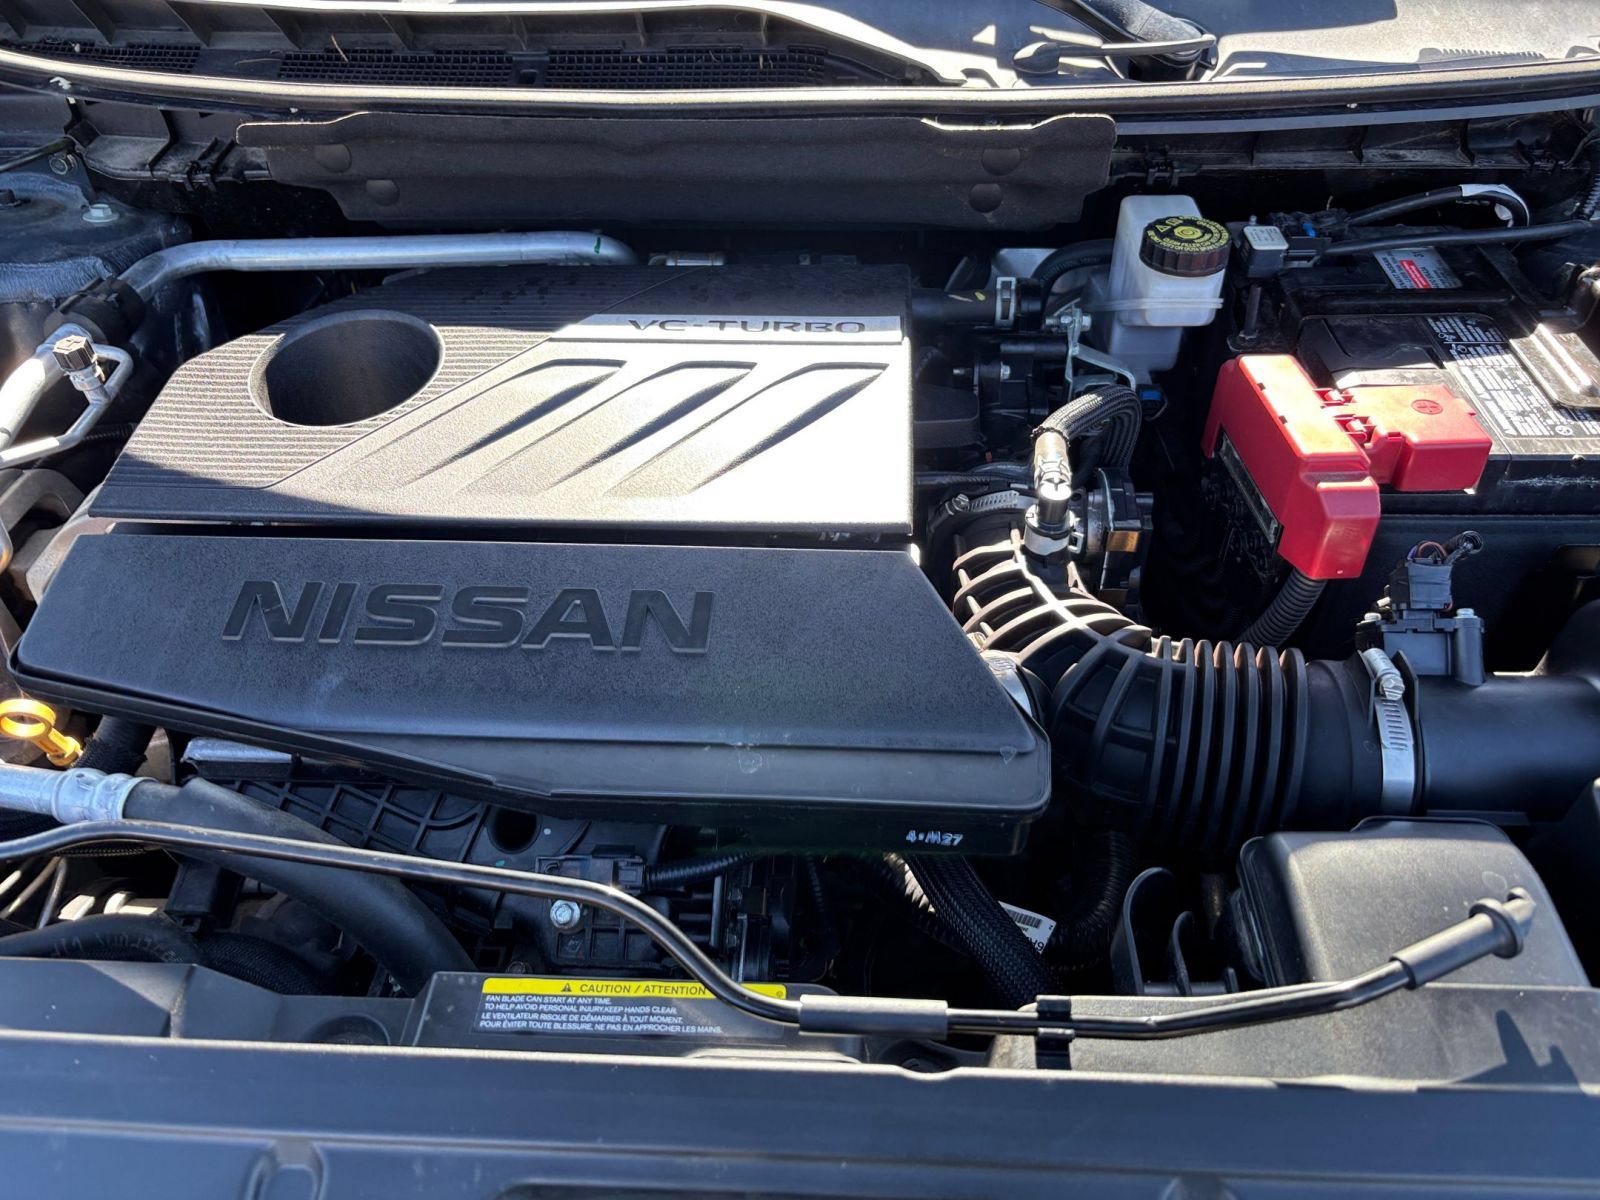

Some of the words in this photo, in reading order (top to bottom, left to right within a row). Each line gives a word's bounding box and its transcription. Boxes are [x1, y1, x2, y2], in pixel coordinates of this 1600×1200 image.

[628, 319, 866, 333] VC-TURBO
[222, 580, 715, 653] NISSAN
[580, 983, 631, 994] CAUTION
[634, 984, 641, 994] /
[643, 984, 707, 996] ATTENTION
[501, 995, 525, 1003] BLADE
[526, 995, 542, 1003] CAN
[543, 996, 566, 1004] START
[495, 1003, 515, 1011] HELP
[515, 1003, 538, 1011] AVOID
[539, 1004, 577, 1012] PERSONAL
[624, 1006, 650, 1014] HANDS
[492, 1012, 539, 1020] VENTILATEUR
[540, 1013, 567, 1021] RISQUE
[580, 1012, 621, 1022] DÉMARRER
[629, 1015, 649, 1023] TOUT
[649, 1015, 683, 1024] MOMENT.
[480, 1020, 501, 1028] POUR
[502, 1019, 527, 1029] ÉVITER
[528, 1020, 552, 1029] TOUTE
[594, 1023, 606, 1031] NE
[606, 1023, 622, 1031] PAS
[622, 1023, 634, 1032] EN
[634, 1023, 680, 1032] APPROCHER
[681, 1025, 696, 1033] LES
